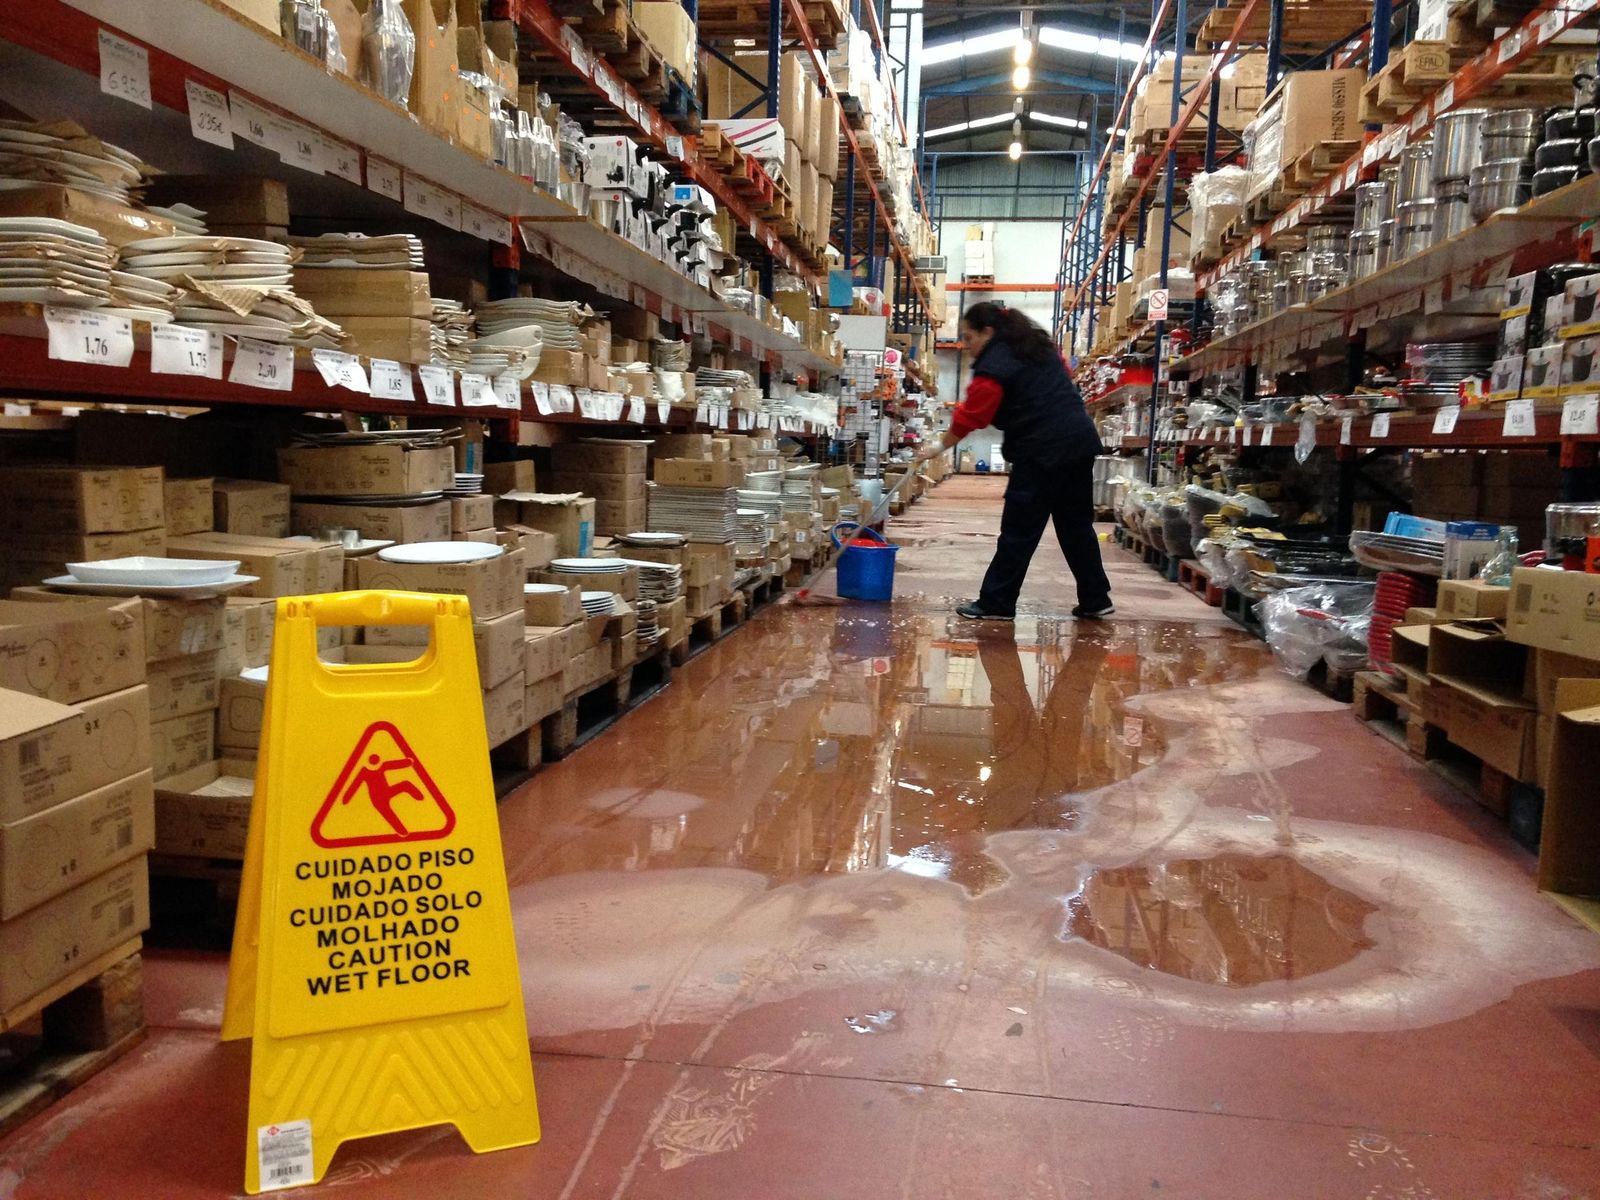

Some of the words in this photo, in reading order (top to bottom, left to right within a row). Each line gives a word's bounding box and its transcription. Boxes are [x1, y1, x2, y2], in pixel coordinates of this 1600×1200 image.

[1419, 56, 1439, 67] EPAL
[85, 335, 109, 357] 1.76
[296, 853, 412, 880] CUIDADO
[419, 848, 475, 869] PISO
[332, 873, 443, 900] MOJADO
[290, 899, 409, 927] CUIDADO
[415, 891, 482, 914] SOLO
[317, 915, 460, 948] MOLHADO
[328, 939, 452, 970] CAUTION
[307, 972, 368, 996] WET
[377, 959, 471, 988] FLOOR
